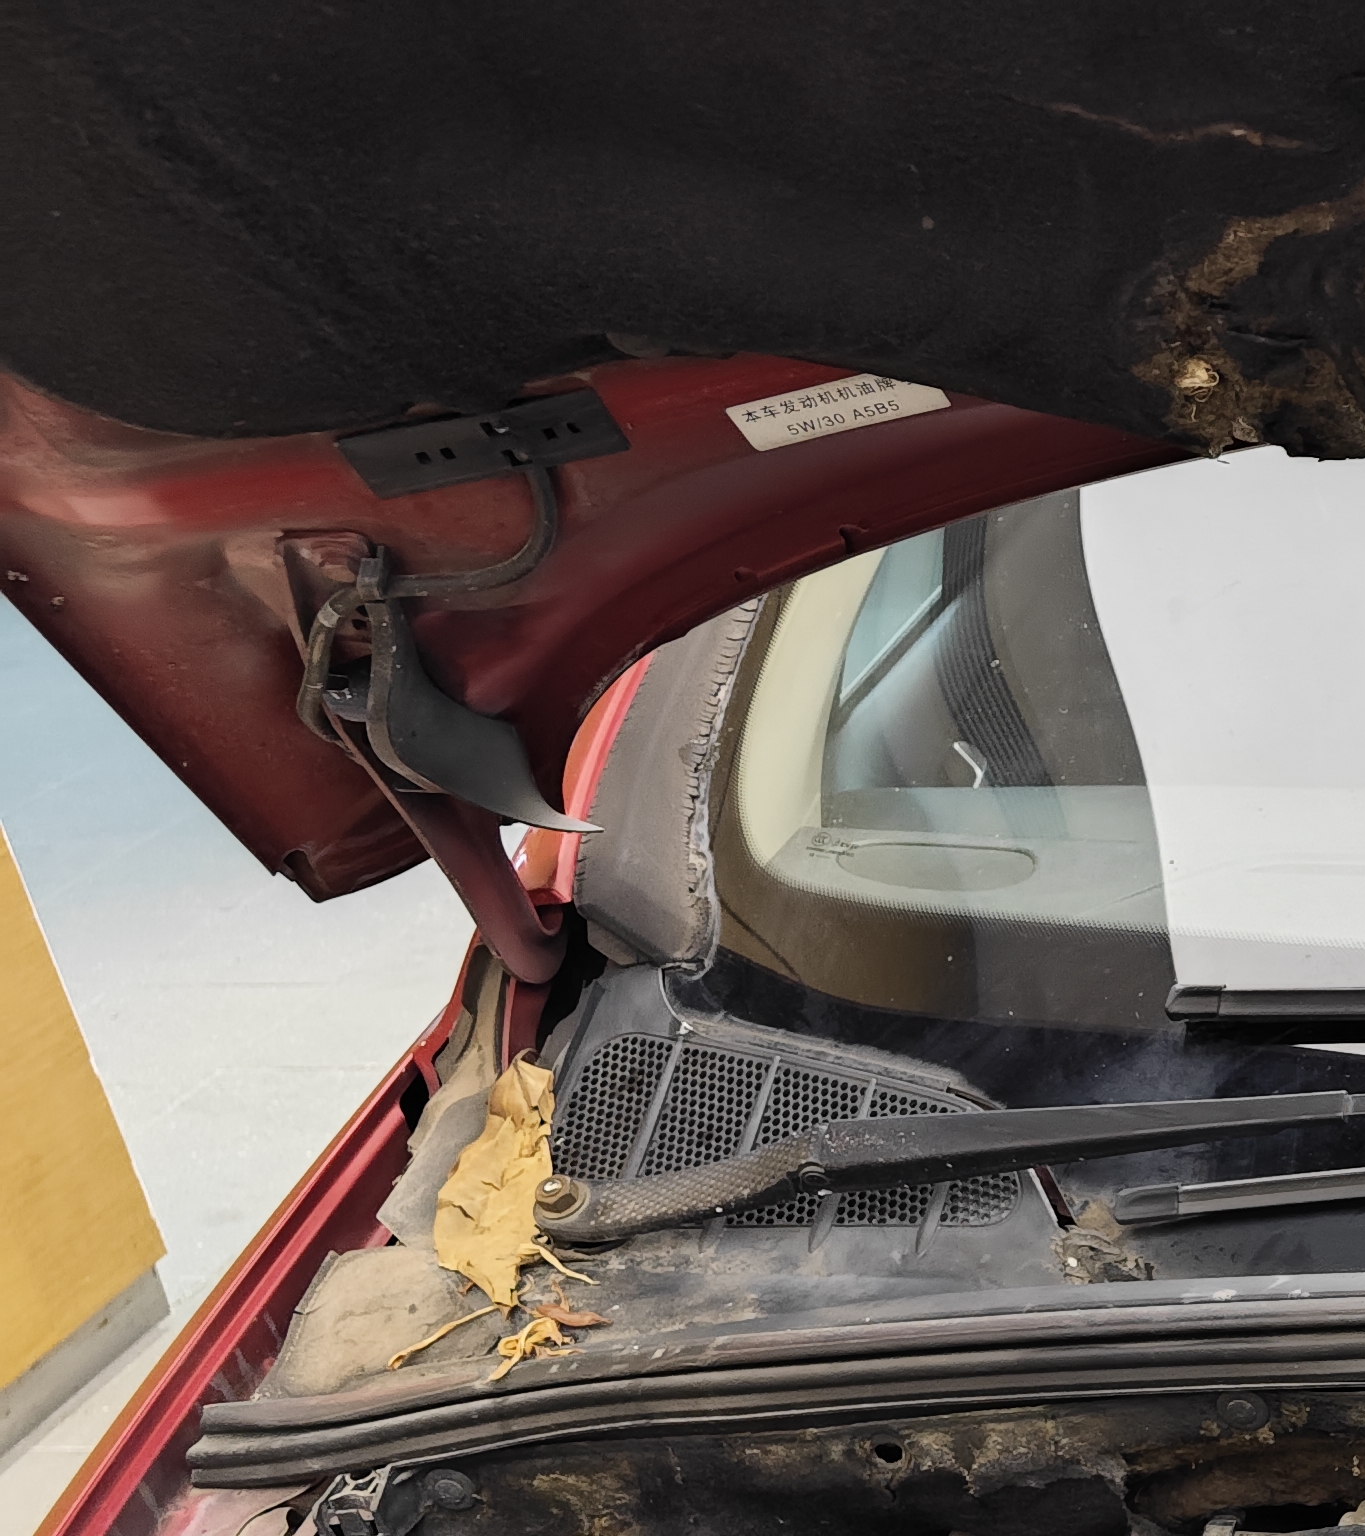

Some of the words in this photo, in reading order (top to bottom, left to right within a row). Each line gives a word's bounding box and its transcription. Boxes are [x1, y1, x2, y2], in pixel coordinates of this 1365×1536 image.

[742, 376, 913, 424] 本车发动机机油牌
[853, 399, 900, 420] A5B5
